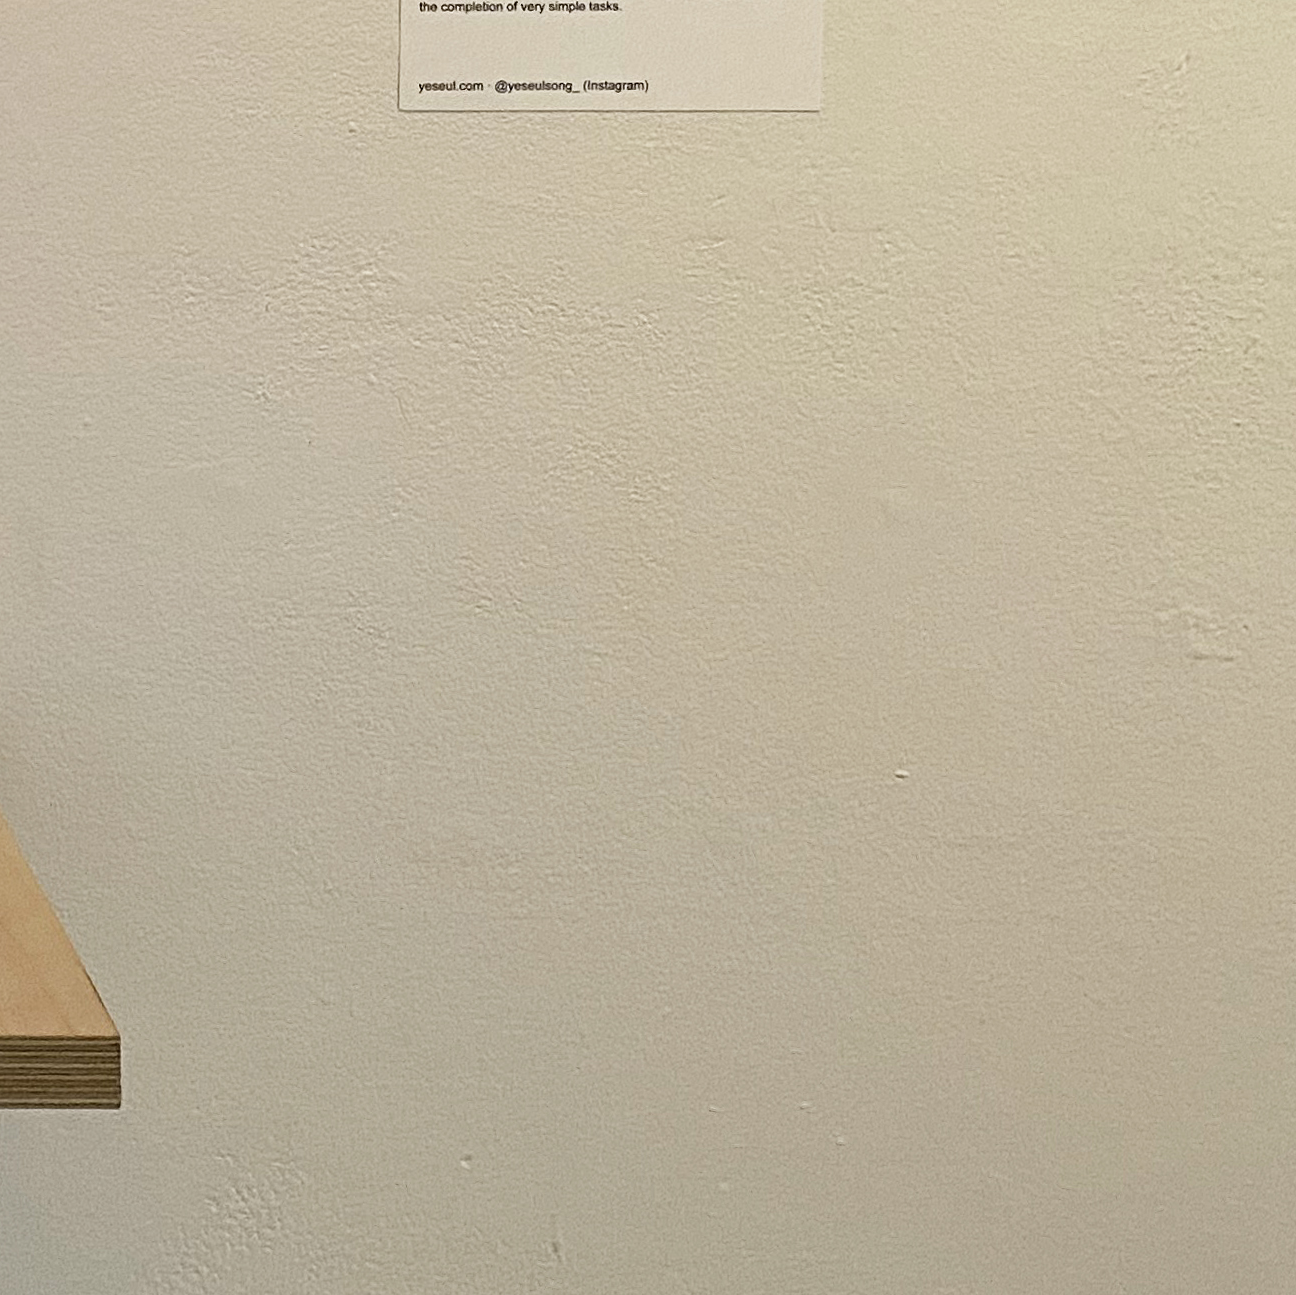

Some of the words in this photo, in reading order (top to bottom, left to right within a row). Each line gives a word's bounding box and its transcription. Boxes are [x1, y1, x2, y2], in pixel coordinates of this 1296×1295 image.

[418, 1, 439, 13] the
[440, 0, 504, 15] completion
[505, 0, 519, 12] of
[520, 2, 546, 15] very
[548, 0, 587, 14] simple
[588, 0, 623, 12] tasks.
[418, 80, 485, 95] yeseul.com
[494, 79, 581, 94] @yeseulsong_
[582, 79, 650, 94] (Instagram)
